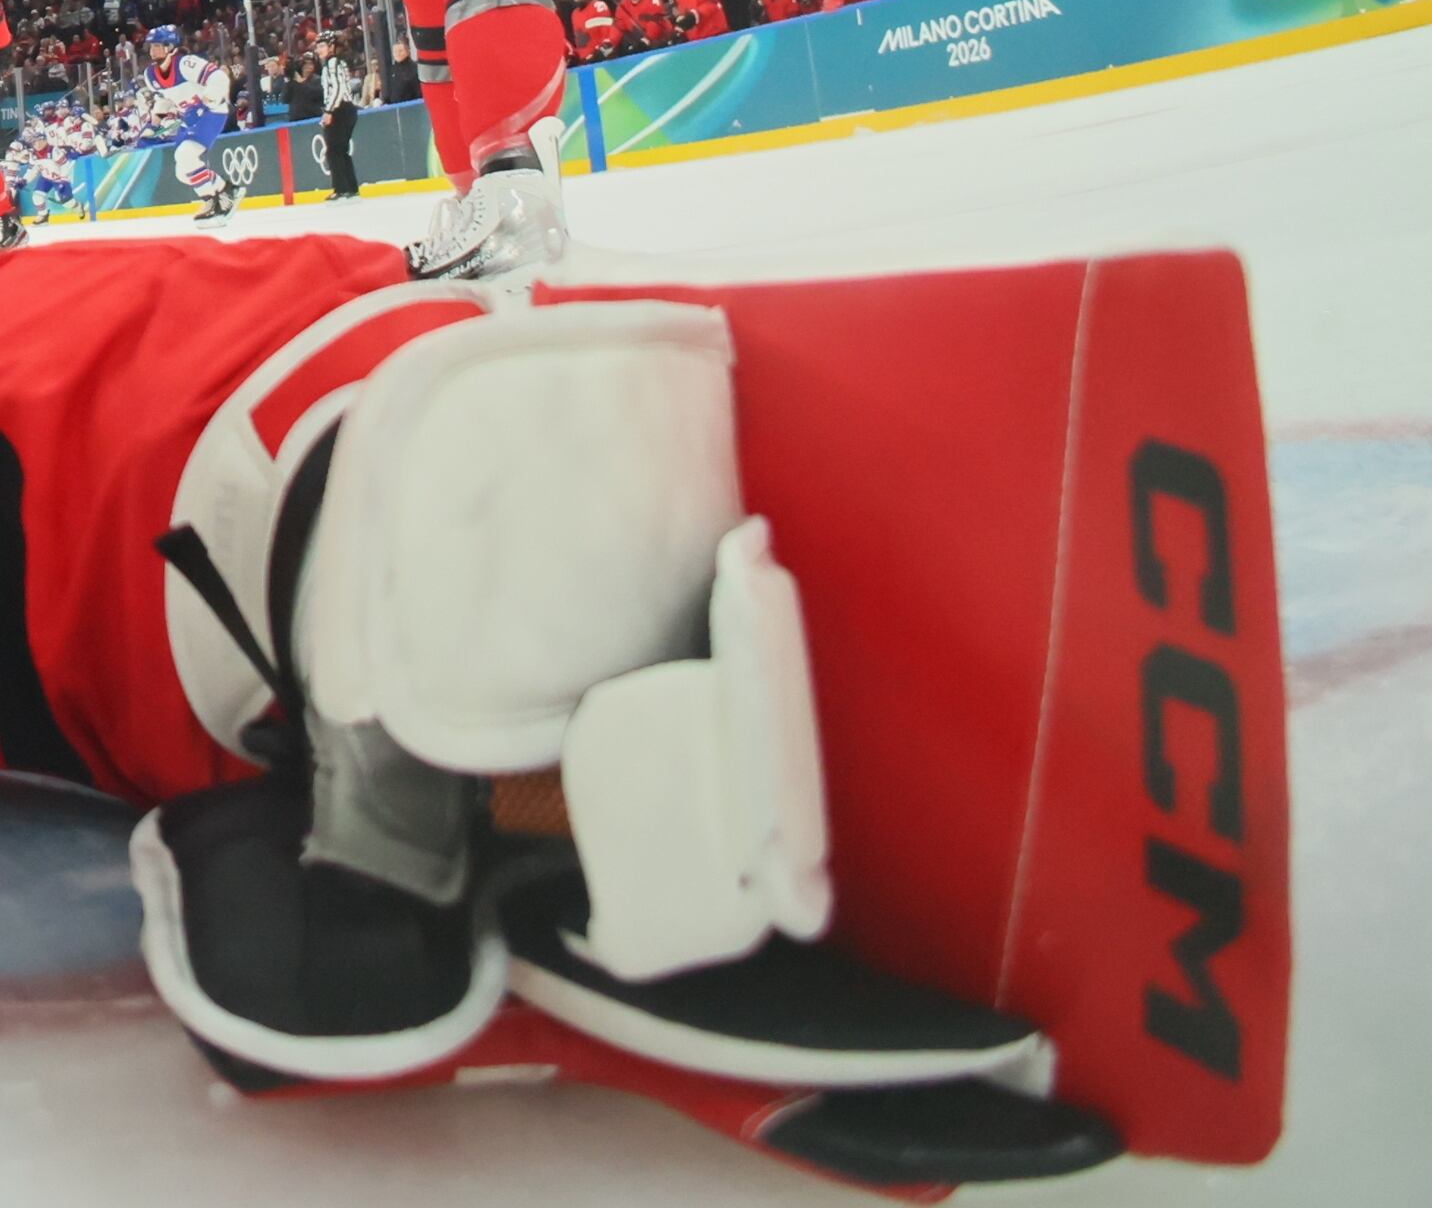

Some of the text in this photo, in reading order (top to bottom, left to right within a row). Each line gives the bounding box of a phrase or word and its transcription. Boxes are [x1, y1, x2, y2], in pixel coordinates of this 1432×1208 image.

[878, 15, 962, 55] MILANO
[946, 36, 992, 67] 2026
[1130, 435, 1247, 1085] CCM
